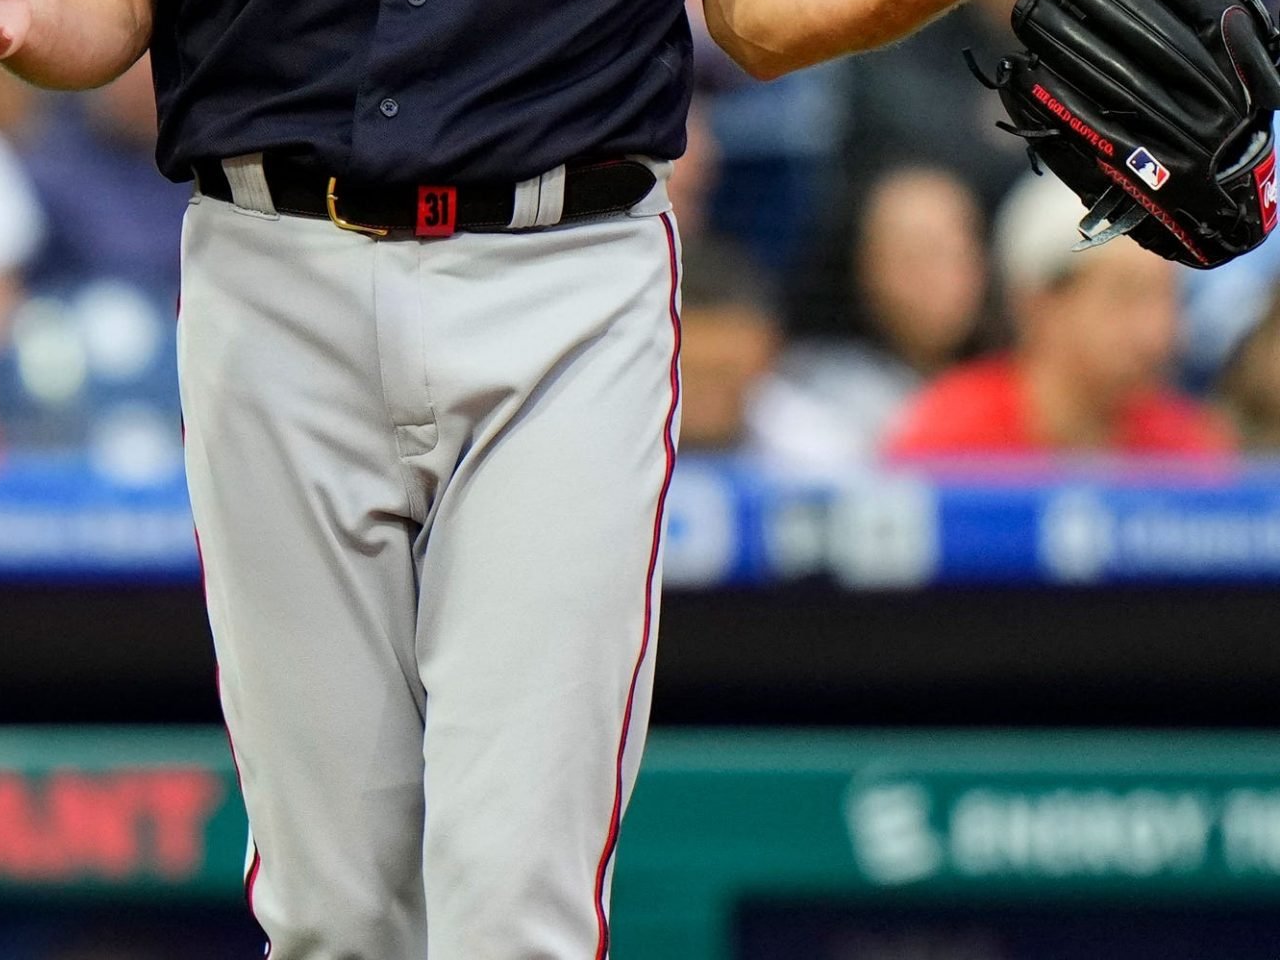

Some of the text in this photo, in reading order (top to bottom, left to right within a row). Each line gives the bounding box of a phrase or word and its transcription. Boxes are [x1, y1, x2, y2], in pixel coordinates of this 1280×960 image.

[1032, 83, 1051, 105] THE
[1047, 98, 1072, 122] GOLD
[1069, 117, 1100, 146] GLOVE
[424, 192, 449, 227] 31
